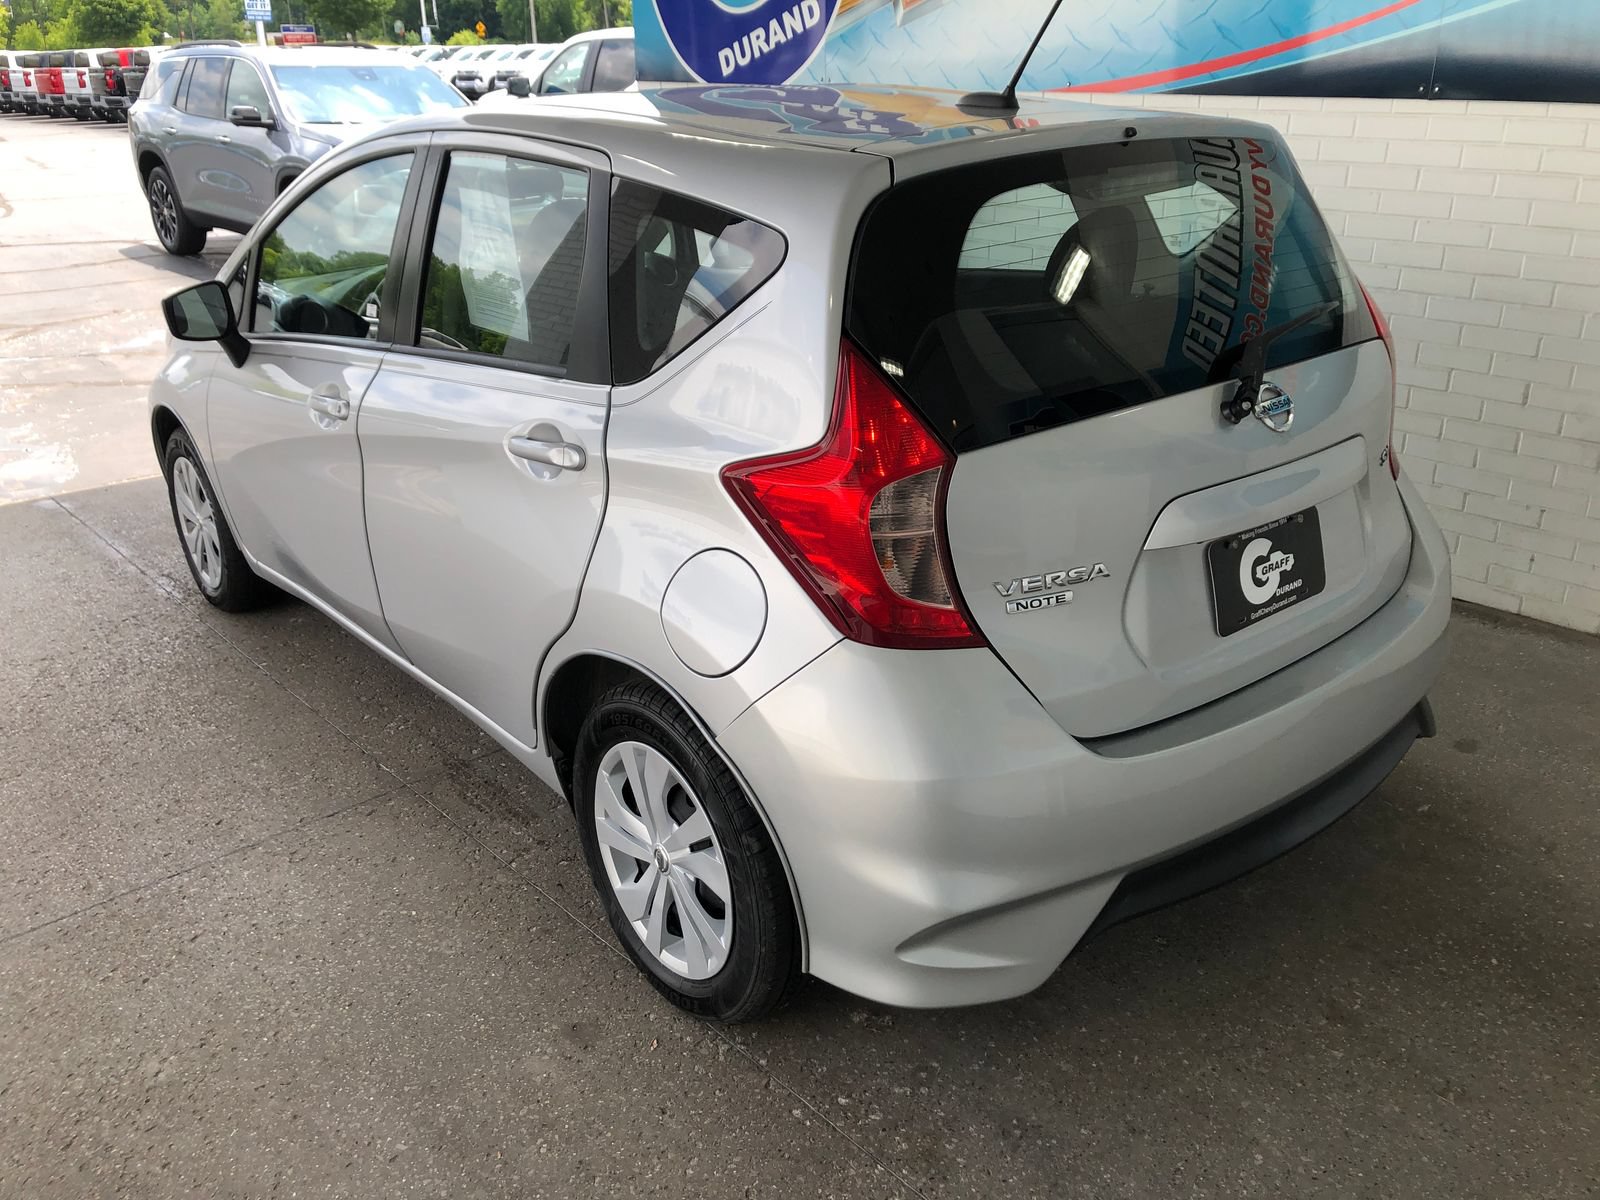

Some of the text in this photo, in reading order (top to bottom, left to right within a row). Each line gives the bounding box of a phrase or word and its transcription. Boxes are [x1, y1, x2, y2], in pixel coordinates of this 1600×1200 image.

[717, 0, 821, 77] DURAND
[1261, 394, 1294, 412] NISSAN
[1261, 556, 1291, 575] GRAFF
[992, 561, 1111, 597] VERSA
[1276, 578, 1303, 597] DURAND
[1015, 593, 1068, 612] NOTE
